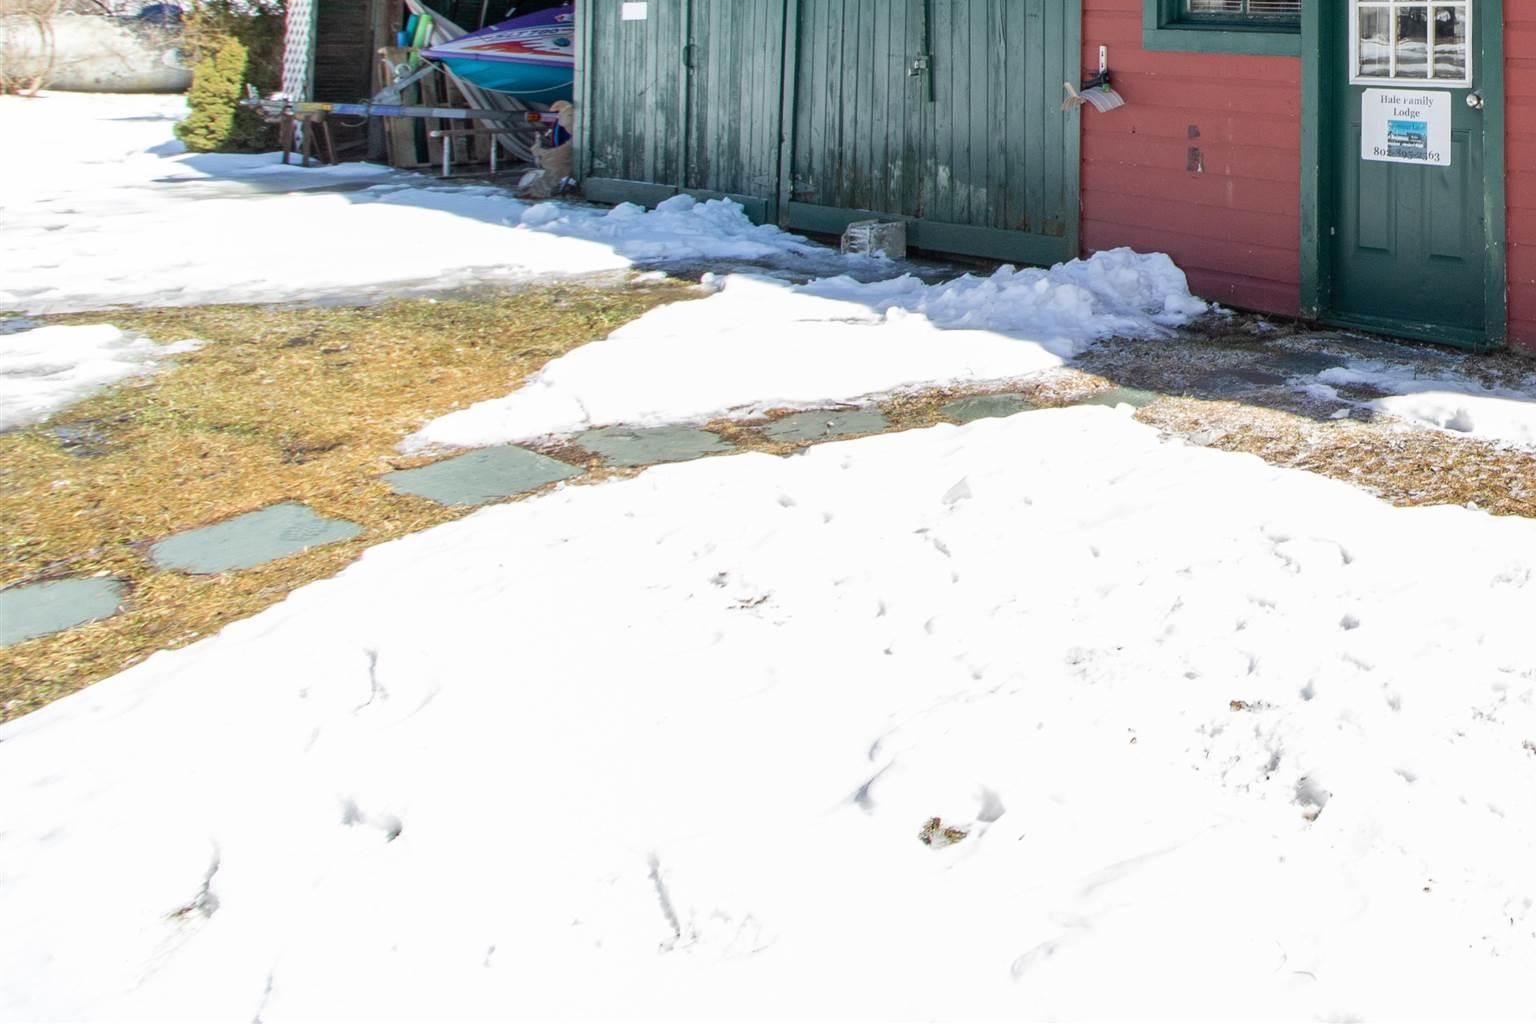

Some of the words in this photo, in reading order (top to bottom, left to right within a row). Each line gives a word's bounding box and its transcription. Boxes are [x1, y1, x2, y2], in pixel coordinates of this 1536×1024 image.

[1380, 95, 1401, 104] Hale
[1403, 96, 1434, 107] Family
[1393, 107, 1421, 119] Lodge
